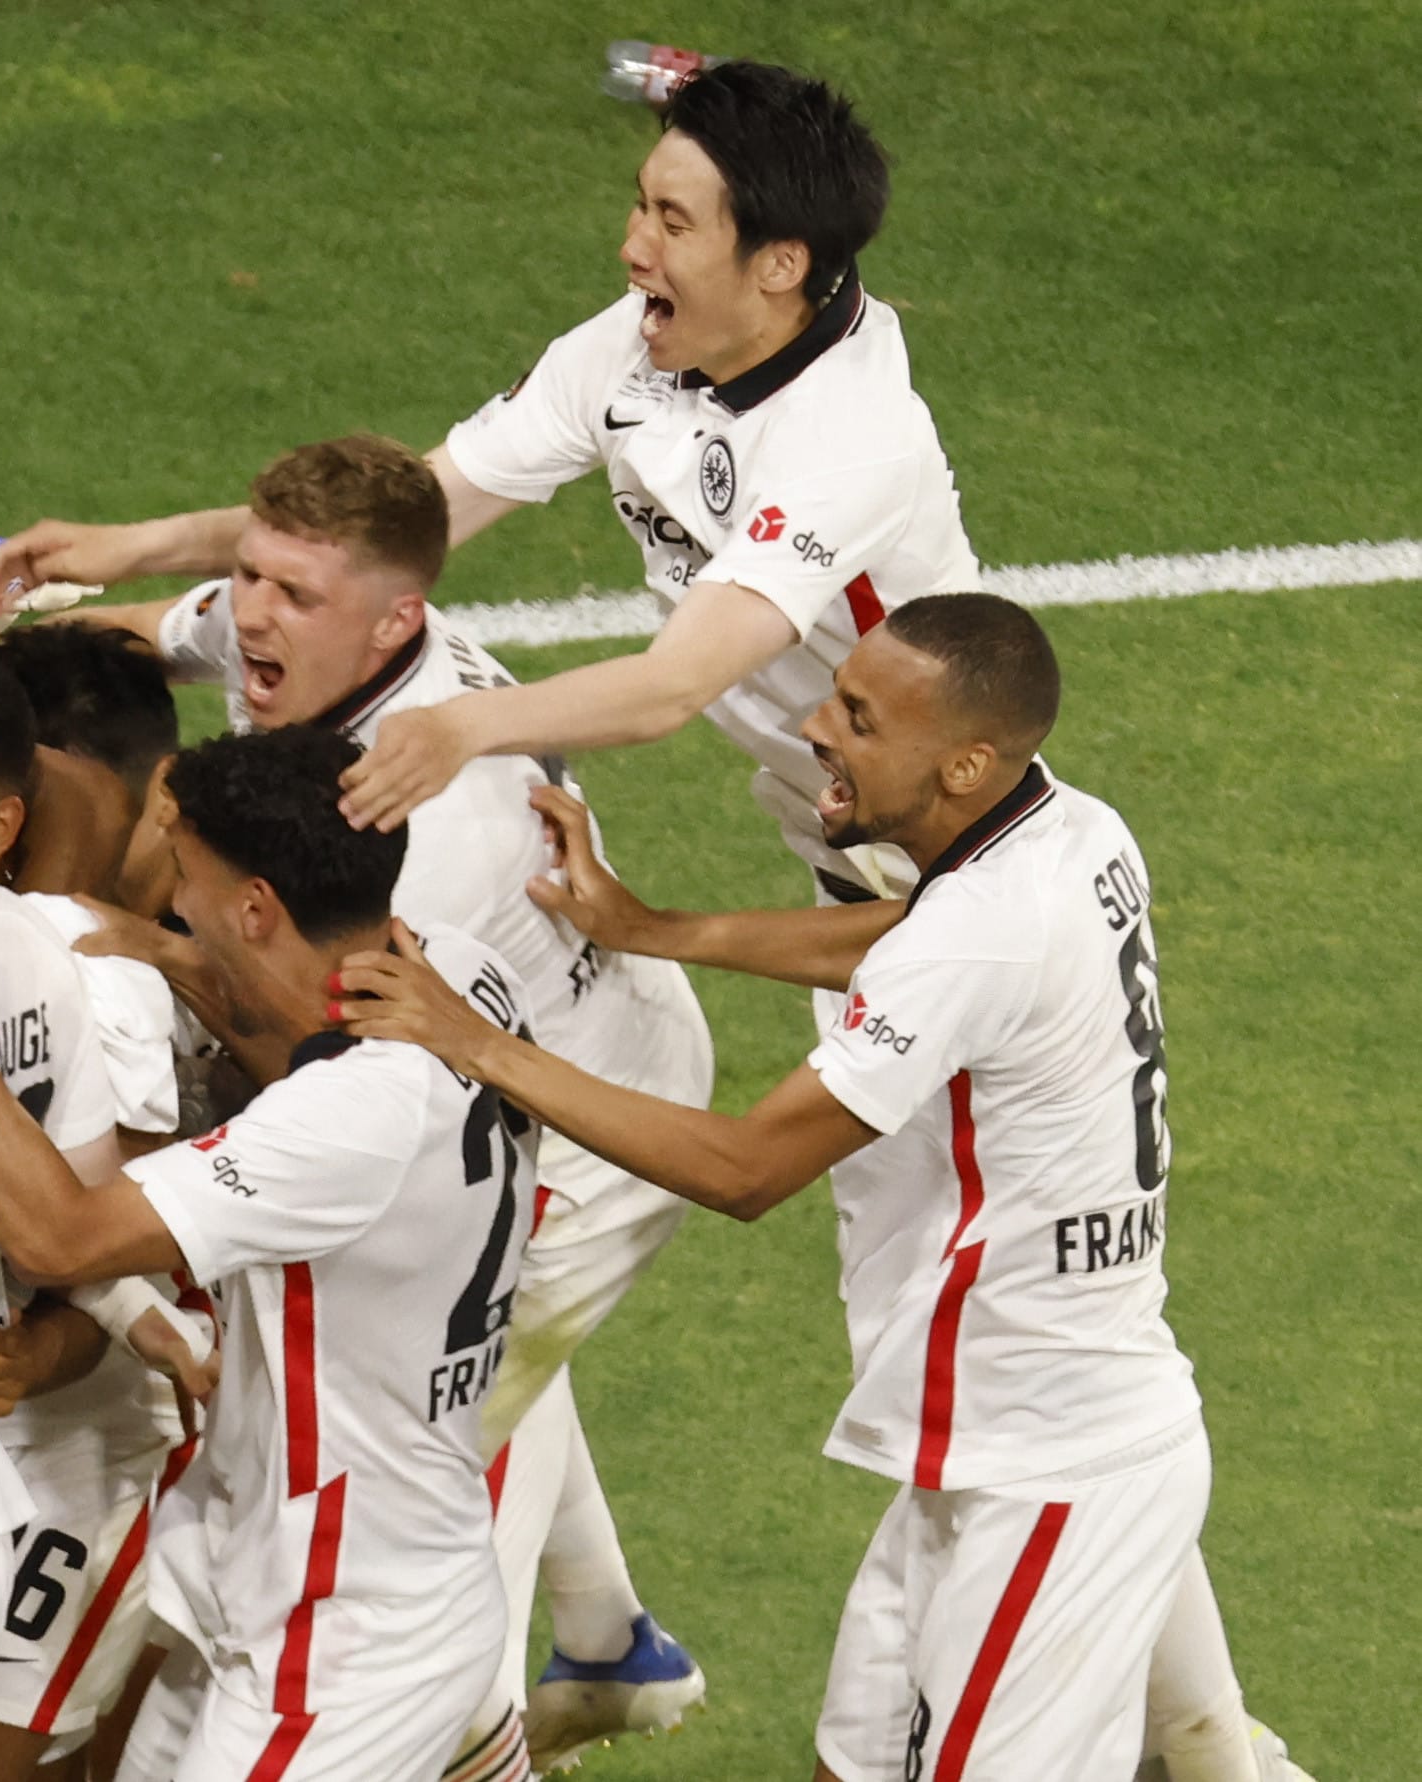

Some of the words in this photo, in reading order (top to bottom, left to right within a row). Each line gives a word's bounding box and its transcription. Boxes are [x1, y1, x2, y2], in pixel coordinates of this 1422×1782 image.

[792, 530, 840, 568] dpd
[863, 1014, 918, 1056] dpd
[1055, 1197, 1164, 1275] FRAN
[3, 1522, 88, 1641] 6
